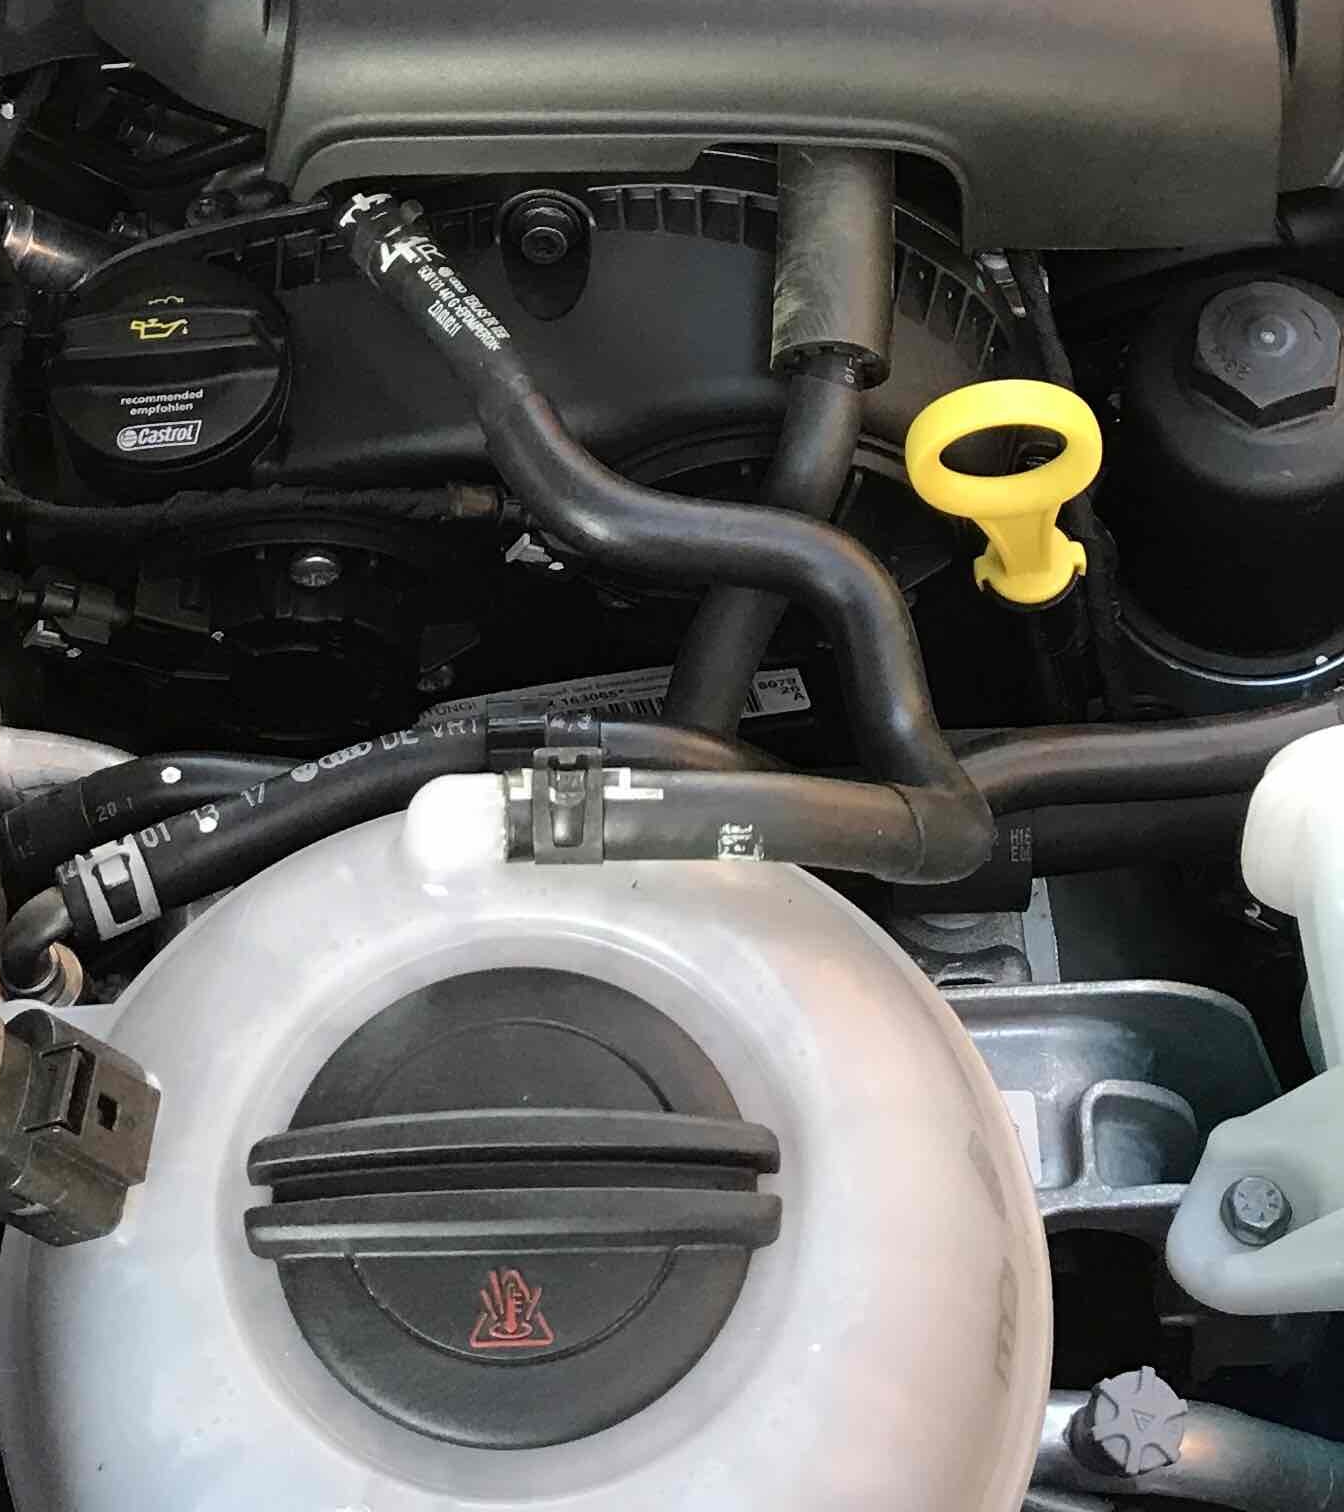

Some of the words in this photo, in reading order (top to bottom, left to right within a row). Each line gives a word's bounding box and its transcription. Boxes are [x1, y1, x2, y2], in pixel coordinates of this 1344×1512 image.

[120, 388, 204, 406] recommended
[129, 402, 194, 417] empfohlen
[137, 424, 194, 445] Castrol
